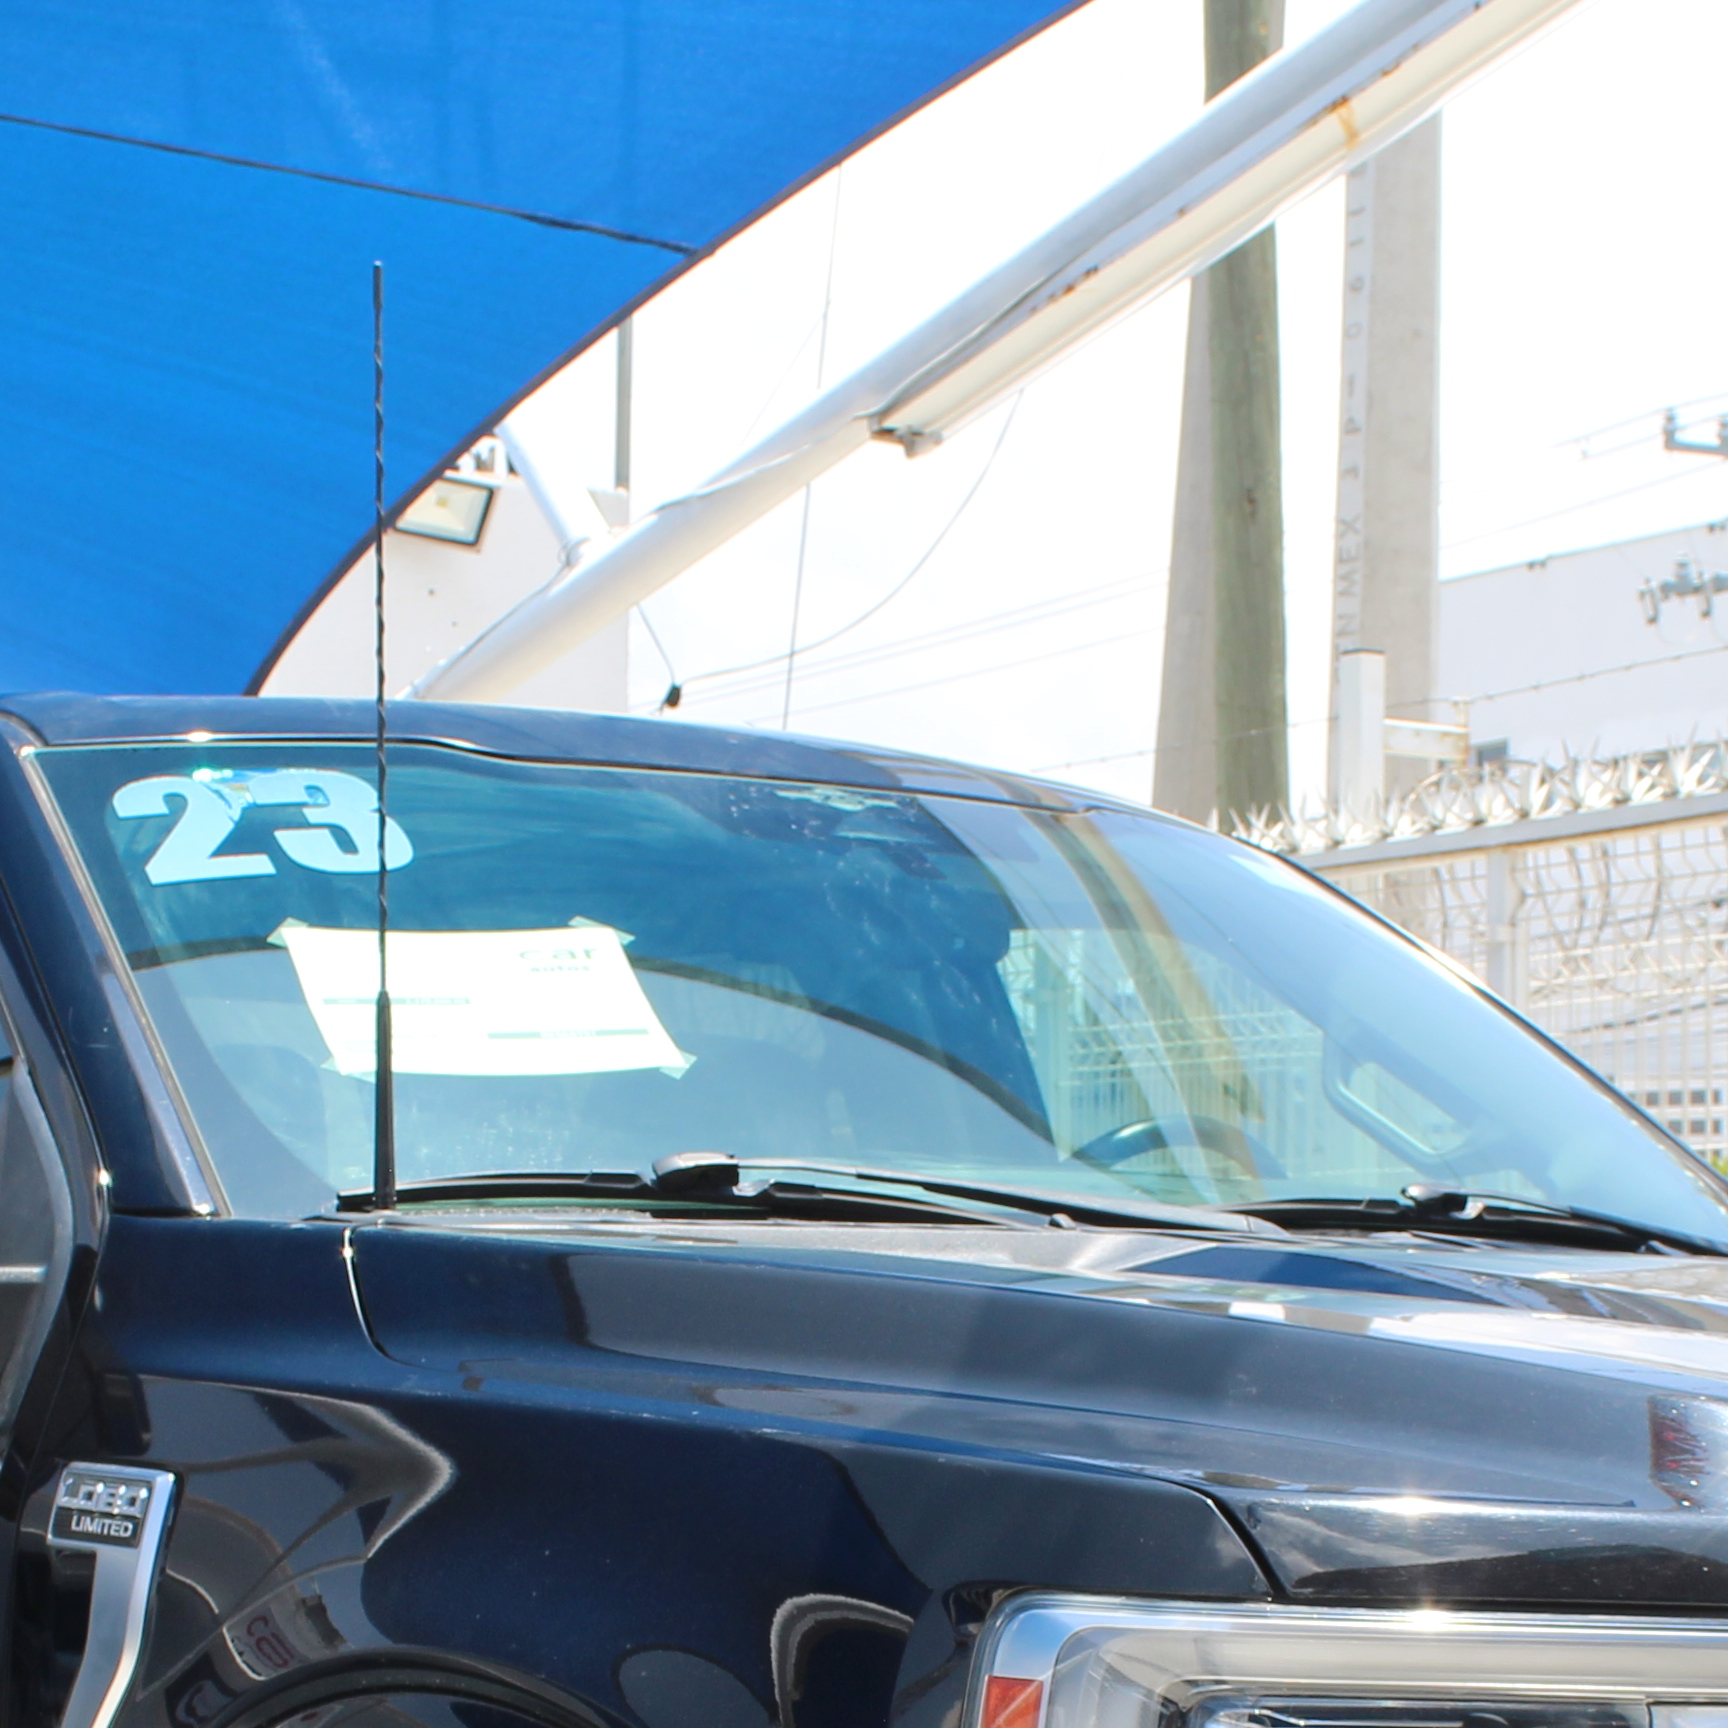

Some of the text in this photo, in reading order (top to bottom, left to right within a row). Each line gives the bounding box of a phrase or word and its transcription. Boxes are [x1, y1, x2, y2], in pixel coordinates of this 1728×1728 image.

[112, 768, 415, 887] 23
[519, 945, 600, 962] car
[70, 1514, 134, 1537] LIMITED
